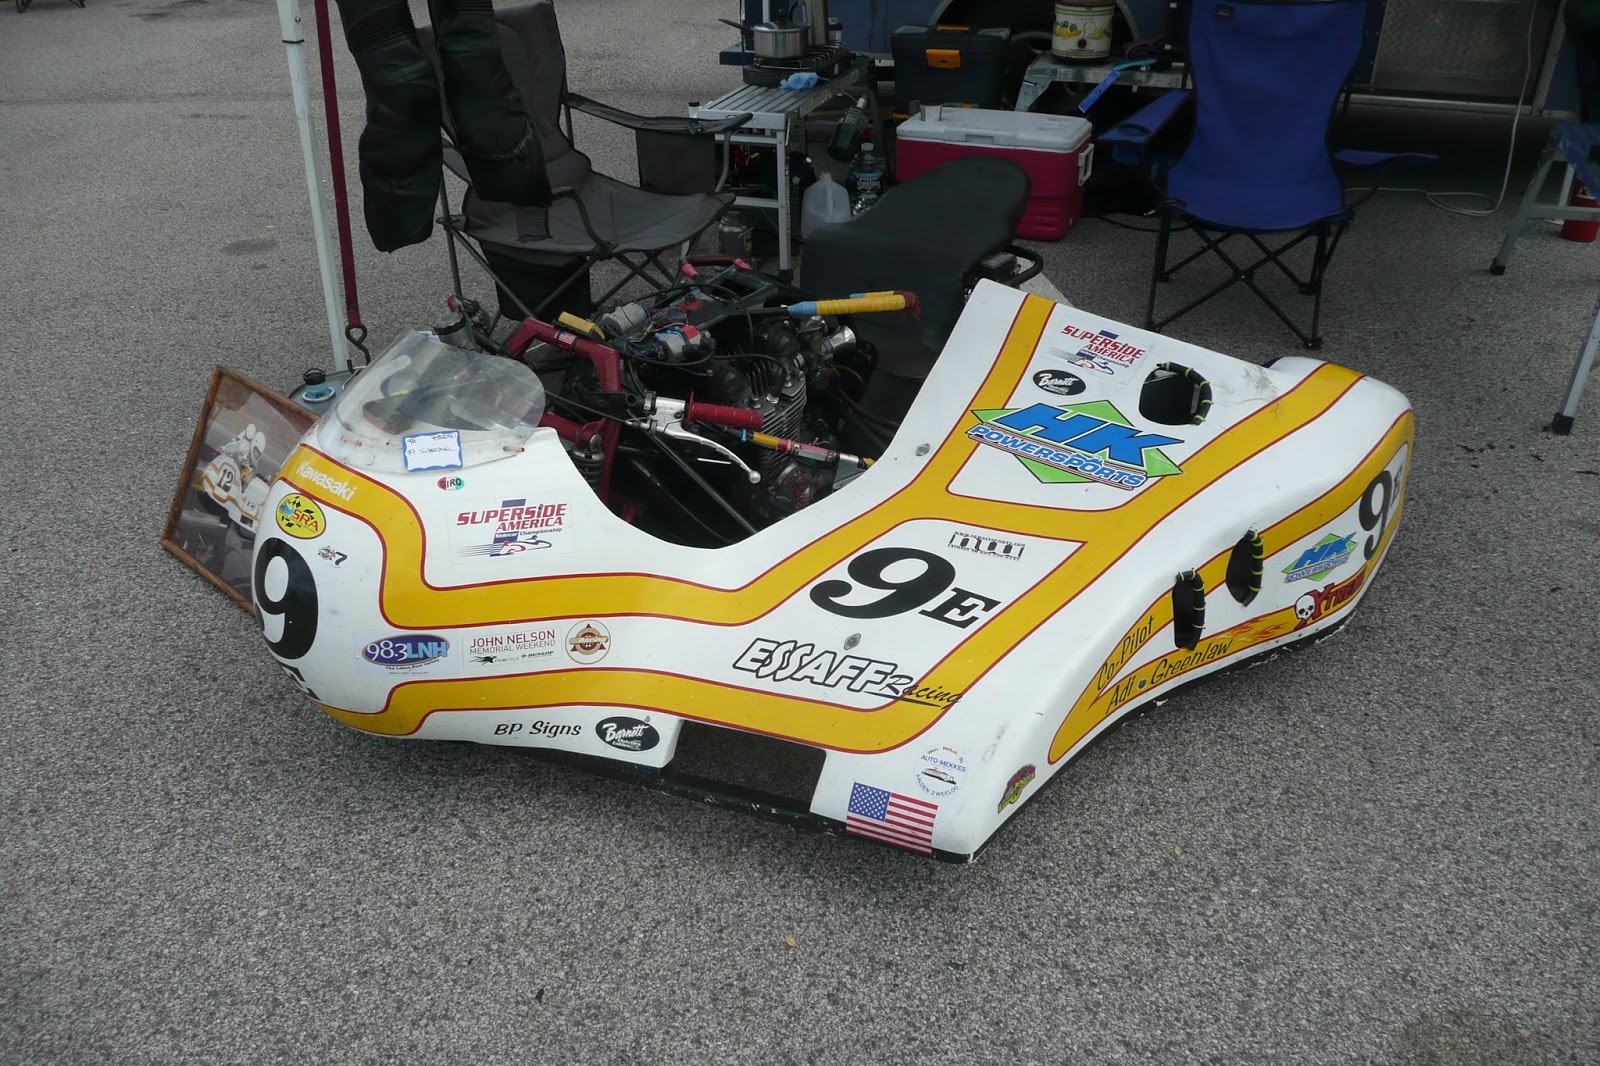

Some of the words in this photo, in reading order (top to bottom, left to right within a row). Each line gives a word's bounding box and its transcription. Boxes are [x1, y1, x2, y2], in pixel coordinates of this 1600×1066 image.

[856, 180, 881, 190] Spring
[1083, 343, 1136, 364] AMERICA
[1038, 373, 1080, 387] Barnett
[966, 425, 1147, 488] POWERSPORTS
[217, 468, 234, 493] 12
[296, 461, 358, 502] Kawasaki
[440, 477, 462, 490] GIRO
[496, 517, 563, 532] AMERICA
[519, 527, 563, 536] Championship
[1285, 553, 1350, 583] POWERSPORTS
[254, 537, 319, 660] 9
[469, 643, 514, 655] MEMORIAL
[516, 640, 556, 651] WEEKEND
[470, 636, 503, 649] JOHN
[506, 629, 556, 645] NELSON
[527, 650, 554, 658] DUNLOP
[1097, 614, 1155, 691] Co-Pilot
[732, 637, 899, 693] ESSAFF
[1105, 675, 1136, 715] Adi
[1150, 638, 1234, 685] Greenlaw
[879, 674, 963, 711] Racing
[494, 723, 523, 736] BP
[529, 721, 582, 738] Signs
[601, 723, 650, 742] Barnett
